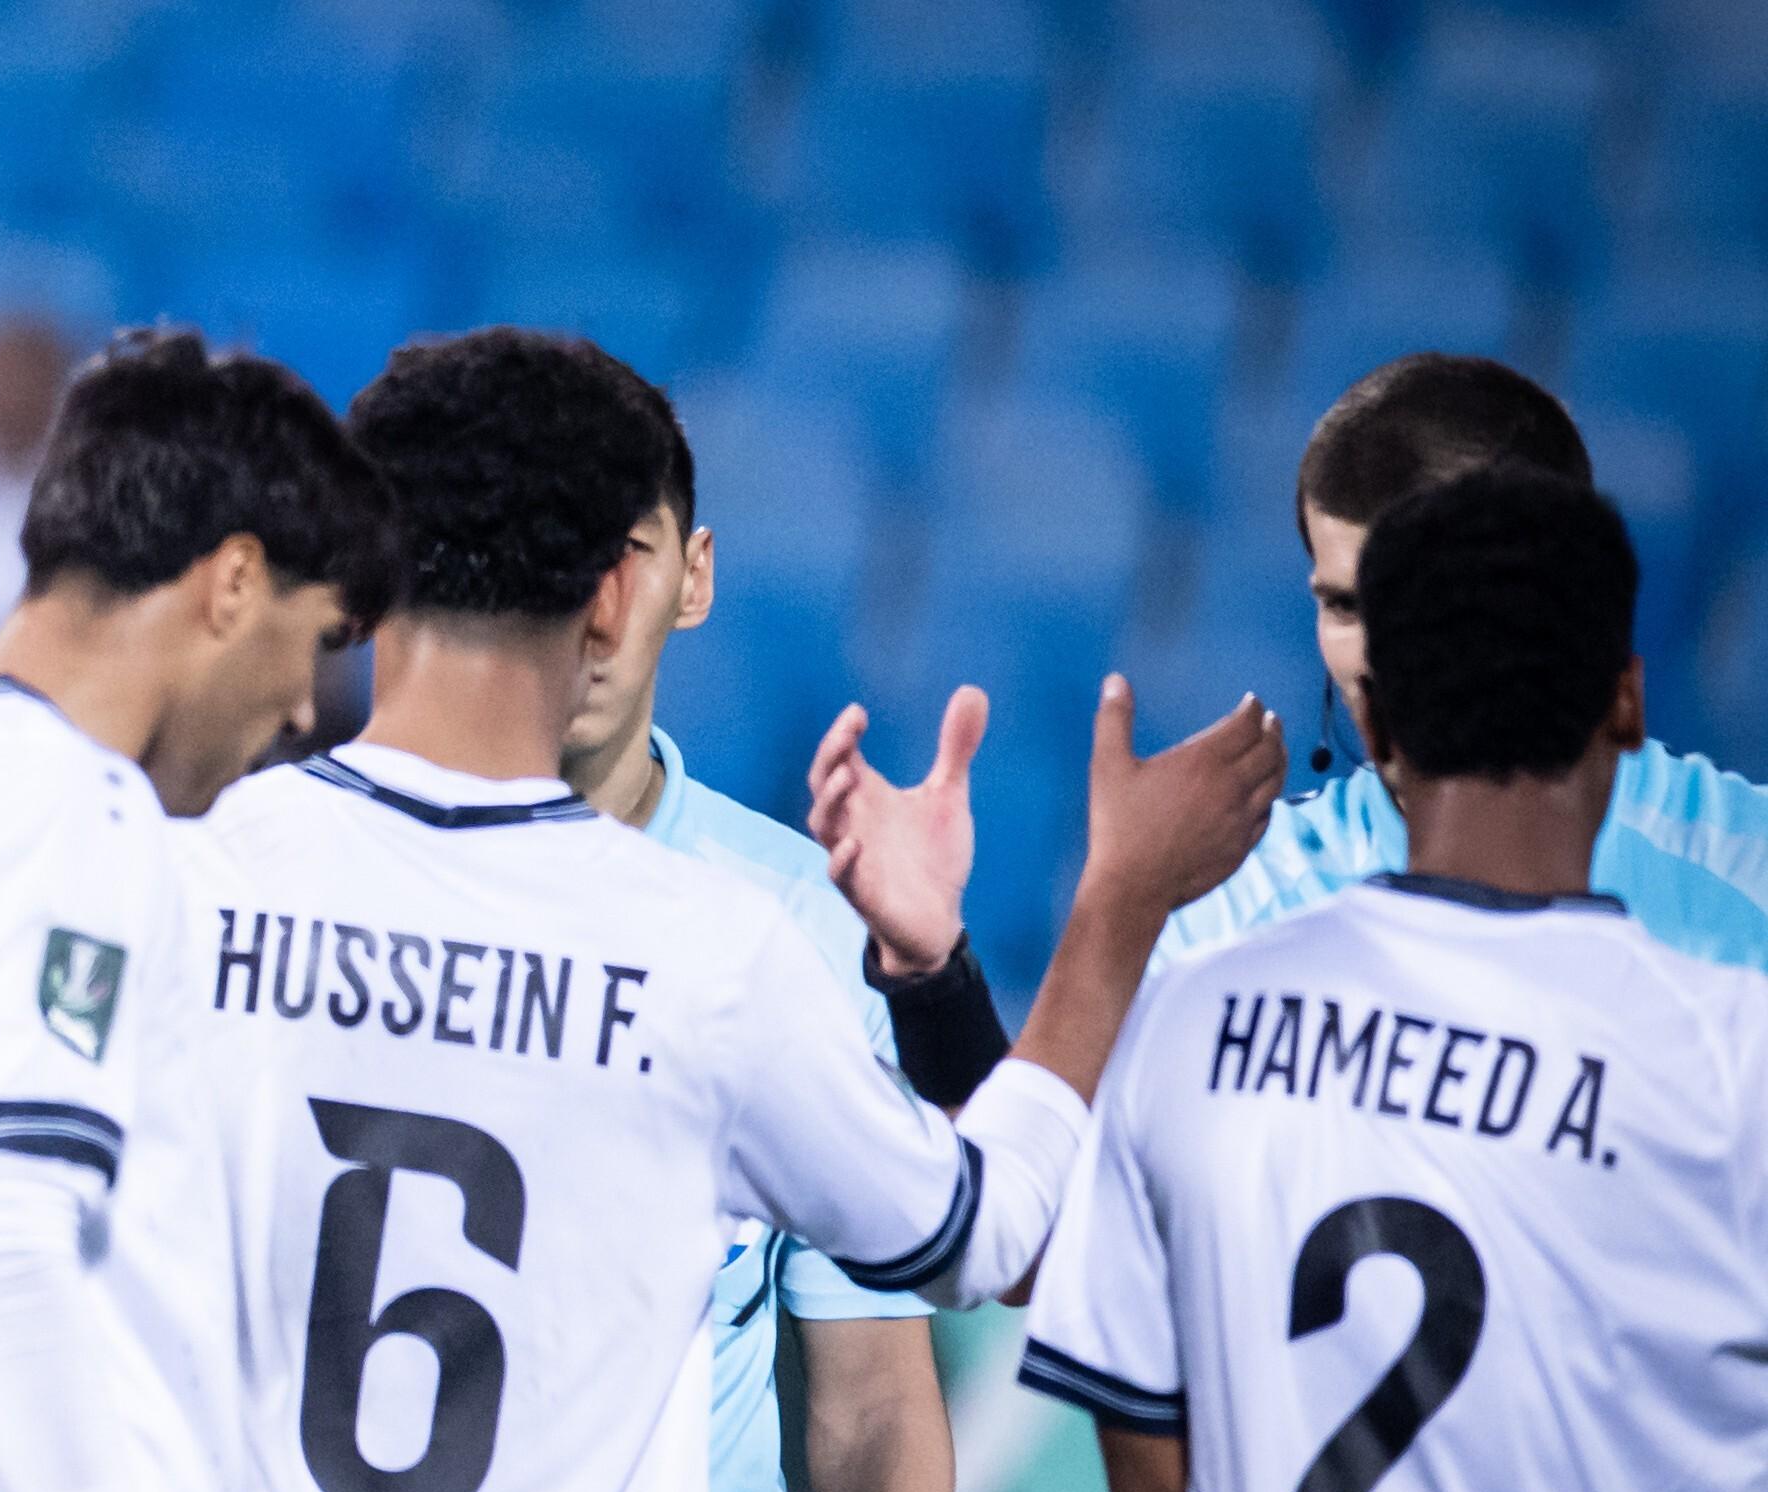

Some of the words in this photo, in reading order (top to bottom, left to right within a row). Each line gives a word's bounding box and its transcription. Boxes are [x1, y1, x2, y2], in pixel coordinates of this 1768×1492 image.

[213, 908, 572, 1059] HUSSEIN
[595, 963, 652, 1073] F.
[1207, 993, 1539, 1139] HAMEED
[1546, 1055, 1620, 1169] A.
